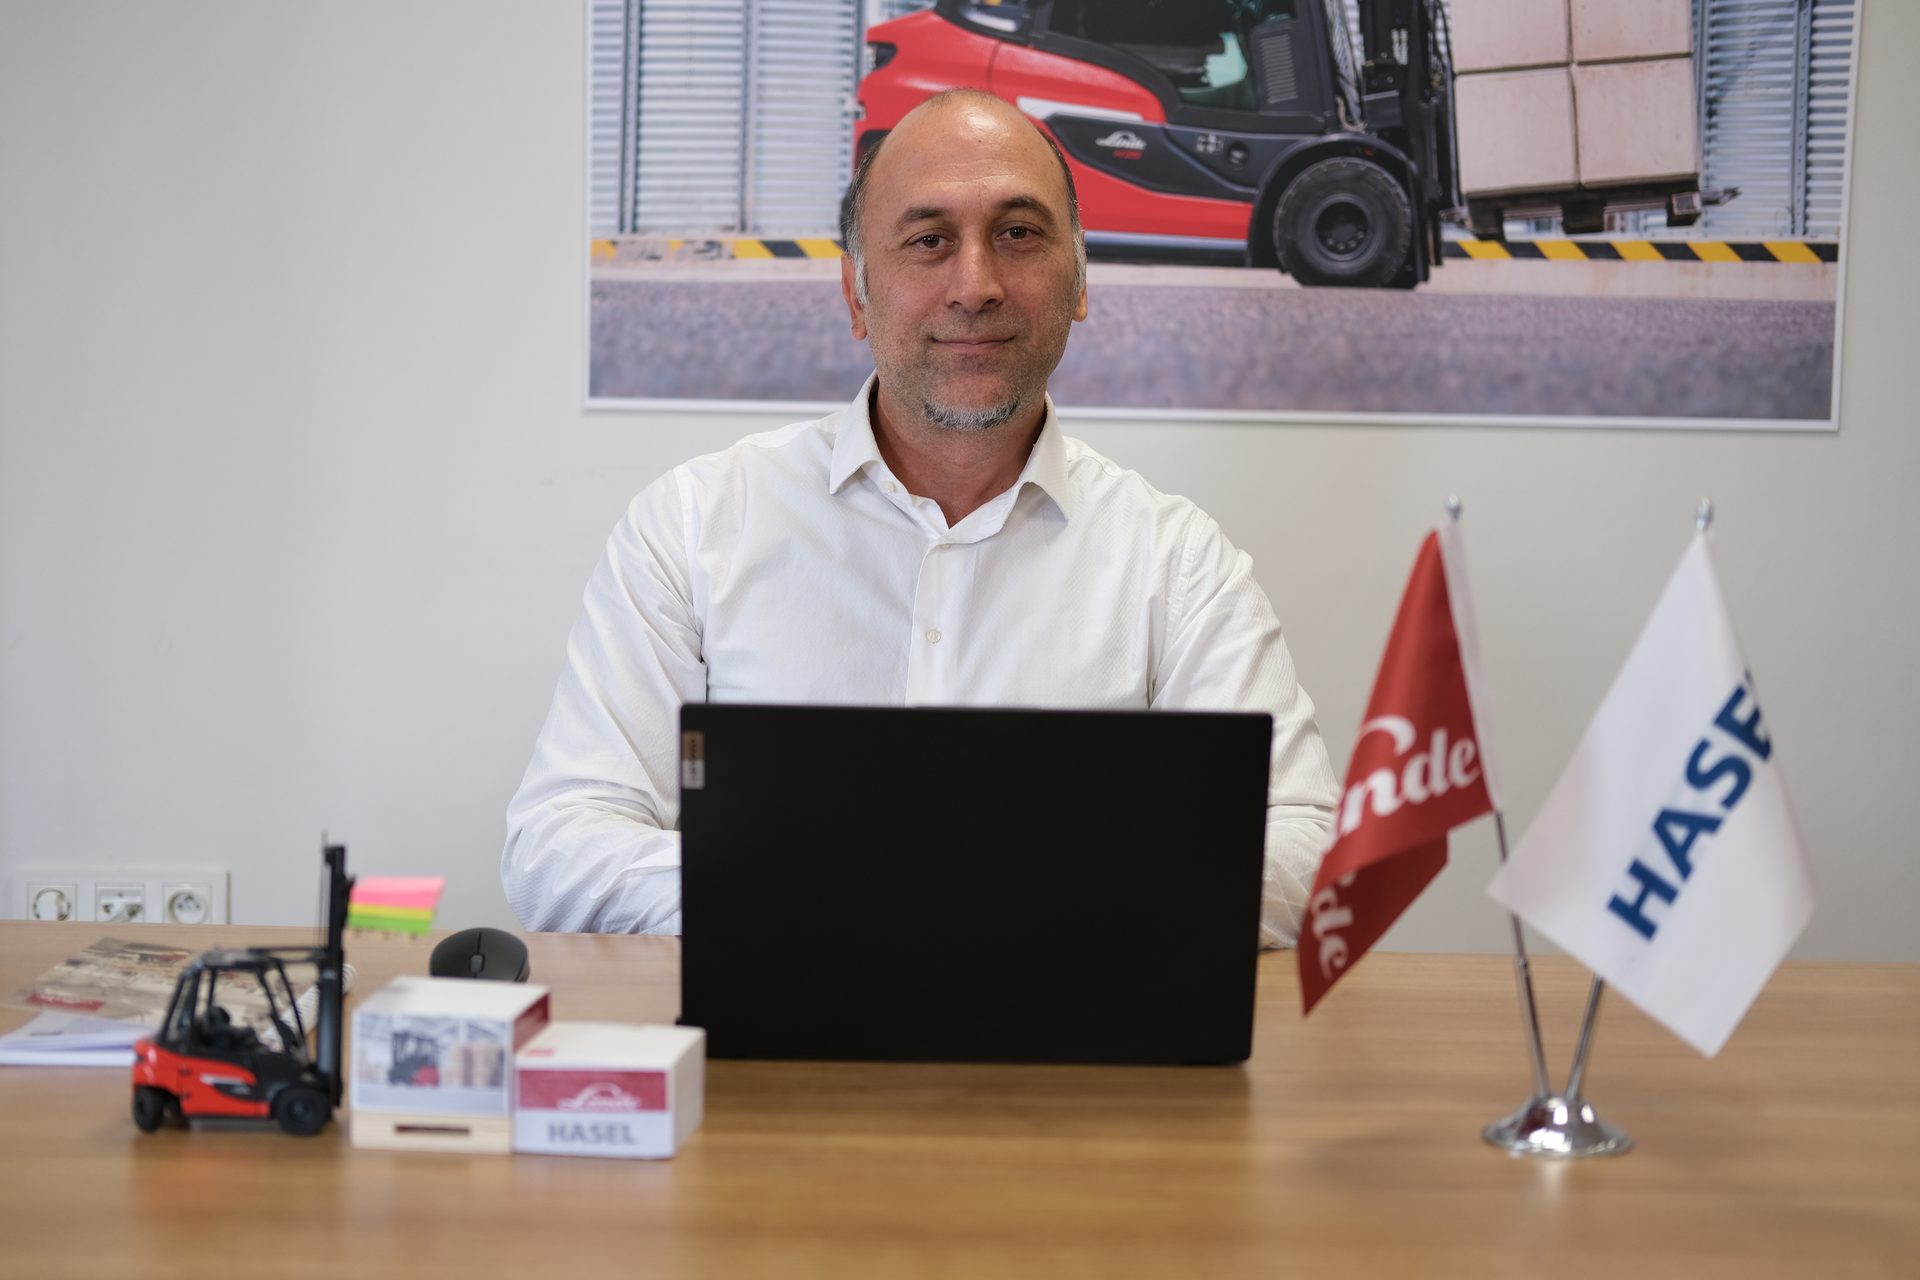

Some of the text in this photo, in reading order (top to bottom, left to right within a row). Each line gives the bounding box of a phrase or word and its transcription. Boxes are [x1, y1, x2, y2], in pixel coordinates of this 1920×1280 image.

[1324, 715, 1483, 855] nde
[1607, 667, 1773, 942] HASE
[549, 1120, 636, 1145] HASEL
